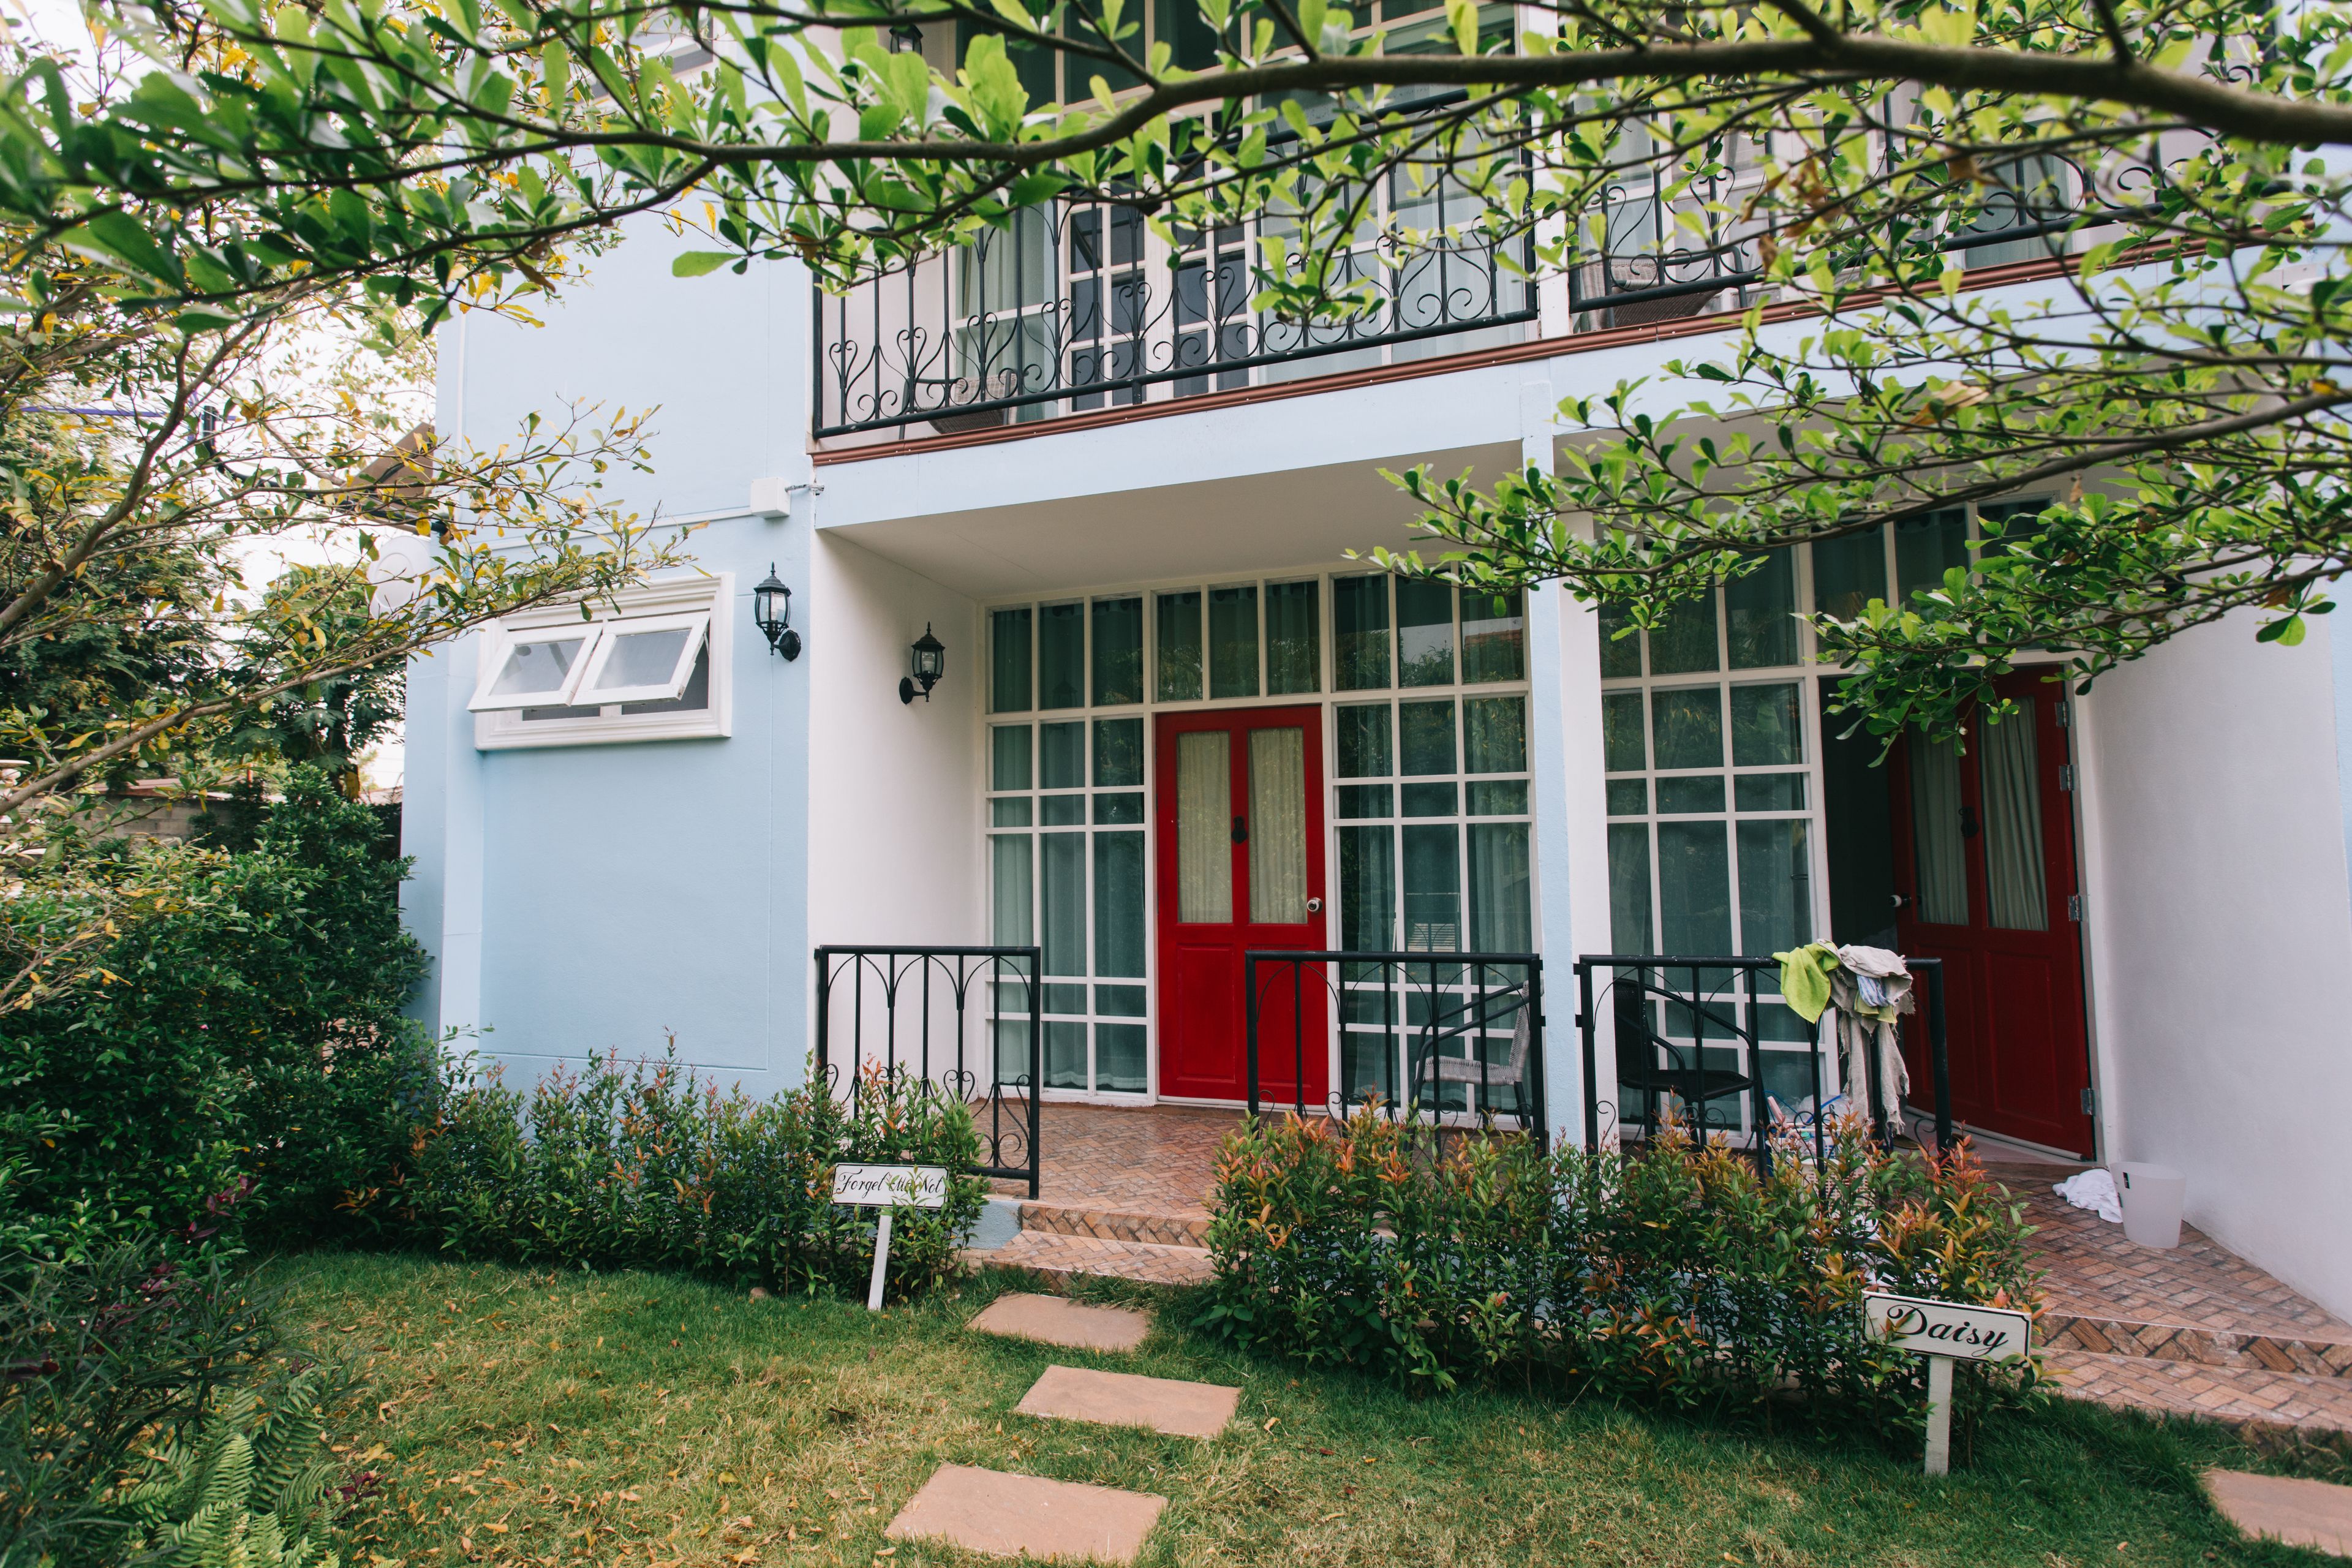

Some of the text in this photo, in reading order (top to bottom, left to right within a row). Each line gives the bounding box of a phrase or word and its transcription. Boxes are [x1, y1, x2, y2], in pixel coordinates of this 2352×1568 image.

[835, 1168, 889, 1199] Forget
[915, 1175, 944, 1194] Not
[1887, 1304, 2008, 1357] Daisy
